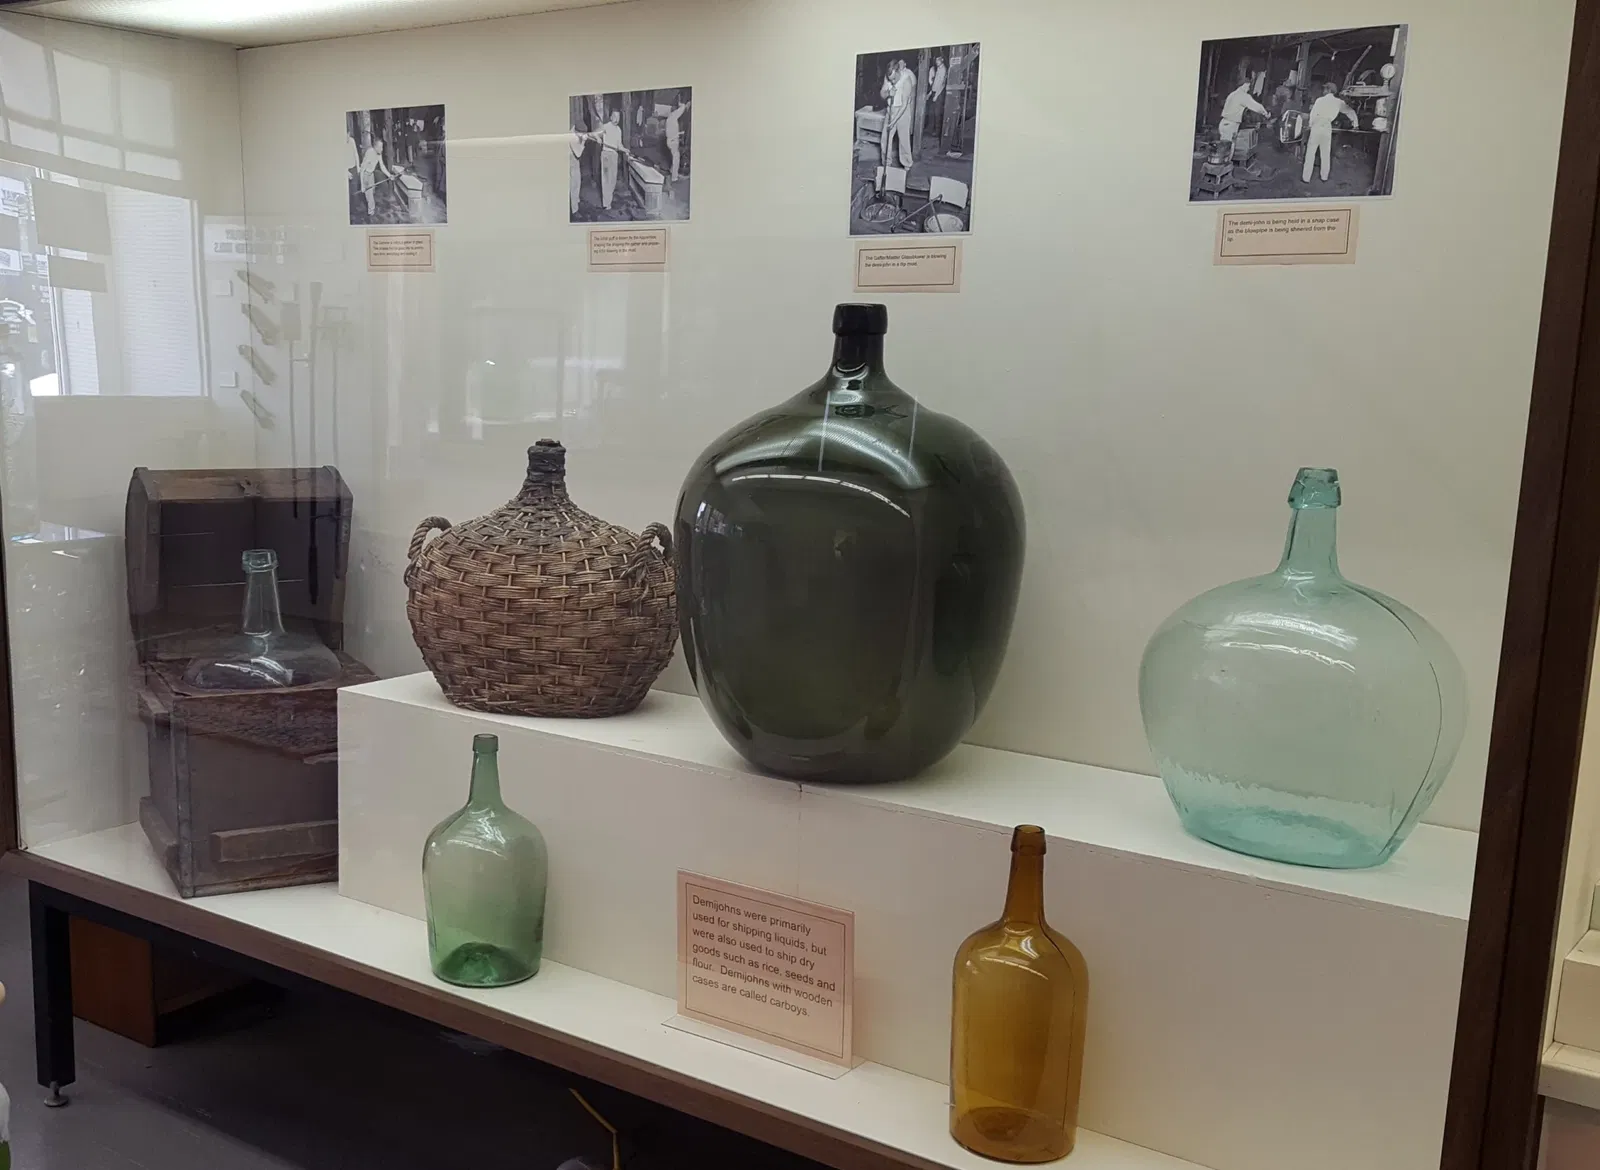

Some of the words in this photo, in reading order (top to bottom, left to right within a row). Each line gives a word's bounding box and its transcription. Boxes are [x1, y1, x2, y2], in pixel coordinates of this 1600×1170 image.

[693, 895, 741, 915] Demijohns
[744, 910, 767, 922] were
[770, 916, 811, 936] primarily
[693, 913, 714, 924] used
[717, 917, 730, 928] for
[733, 922, 771, 942] shipping
[775, 932, 808, 951] liquids,
[811, 943, 827, 956] but
[692, 928, 715, 940] were
[718, 934, 737, 946] also
[739, 941, 762, 953] used
[765, 947, 774, 956] to
[777, 950, 796, 964] ship
[800, 957, 814, 970] dry
[692, 944, 720, 957] goods
[723, 951, 745, 964] such
[748, 960, 759, 968] as
[762, 962, 782, 976] rice,
[785, 969, 814, 985] seeds
[816, 978, 836, 991] and
[692, 957, 715, 971] flour.
[720, 965, 769, 988] Demijohns
[773, 982, 791, 994] with
[794, 988, 833, 1007] wooden
[692, 975, 719, 988] cases
[722, 984, 737, 993] are
[740, 988, 767, 1003] called
[770, 998, 809, 1016] carboys.
